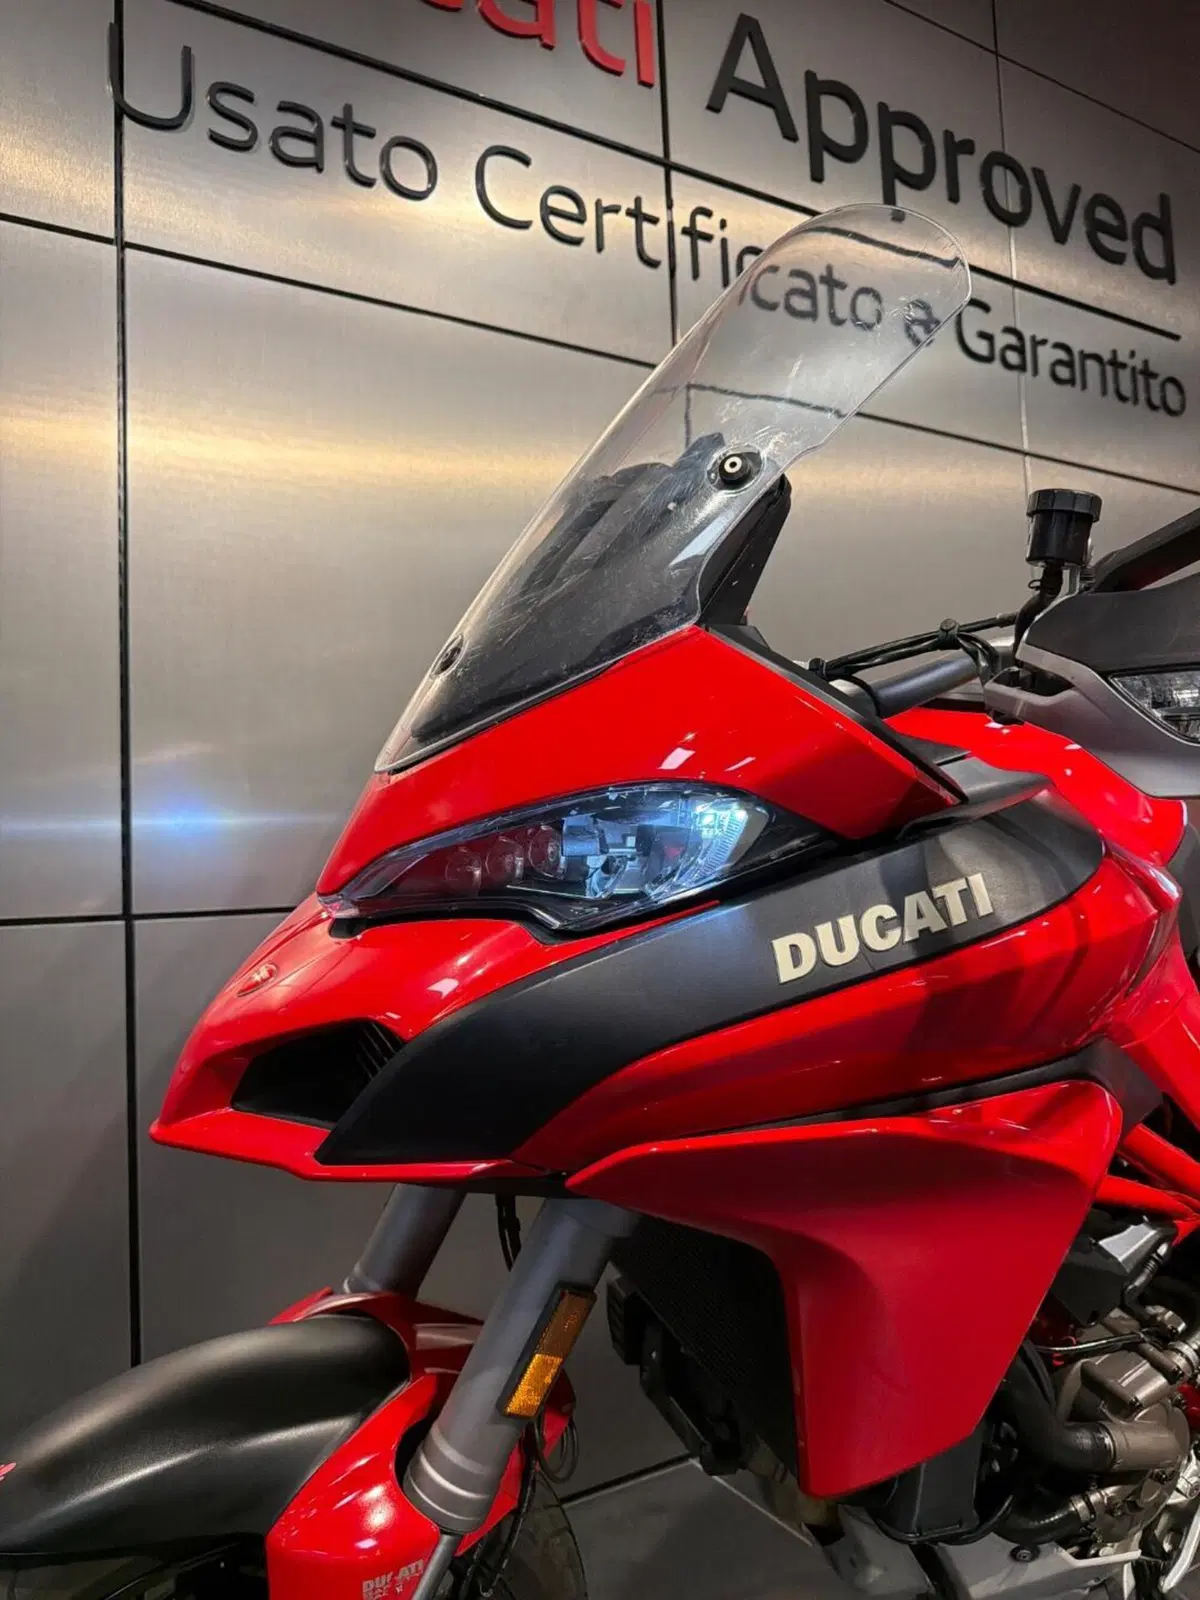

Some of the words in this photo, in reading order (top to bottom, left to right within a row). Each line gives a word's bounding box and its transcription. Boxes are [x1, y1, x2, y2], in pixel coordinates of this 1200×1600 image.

[107, 21, 439, 200] Usato
[474, 145, 884, 332] Certificato
[955, 297, 1186, 418] Garantito
[420, 0, 656, 89] ati
[704, 12, 1177, 285] Approved
[771, 872, 995, 984] DUCATI
